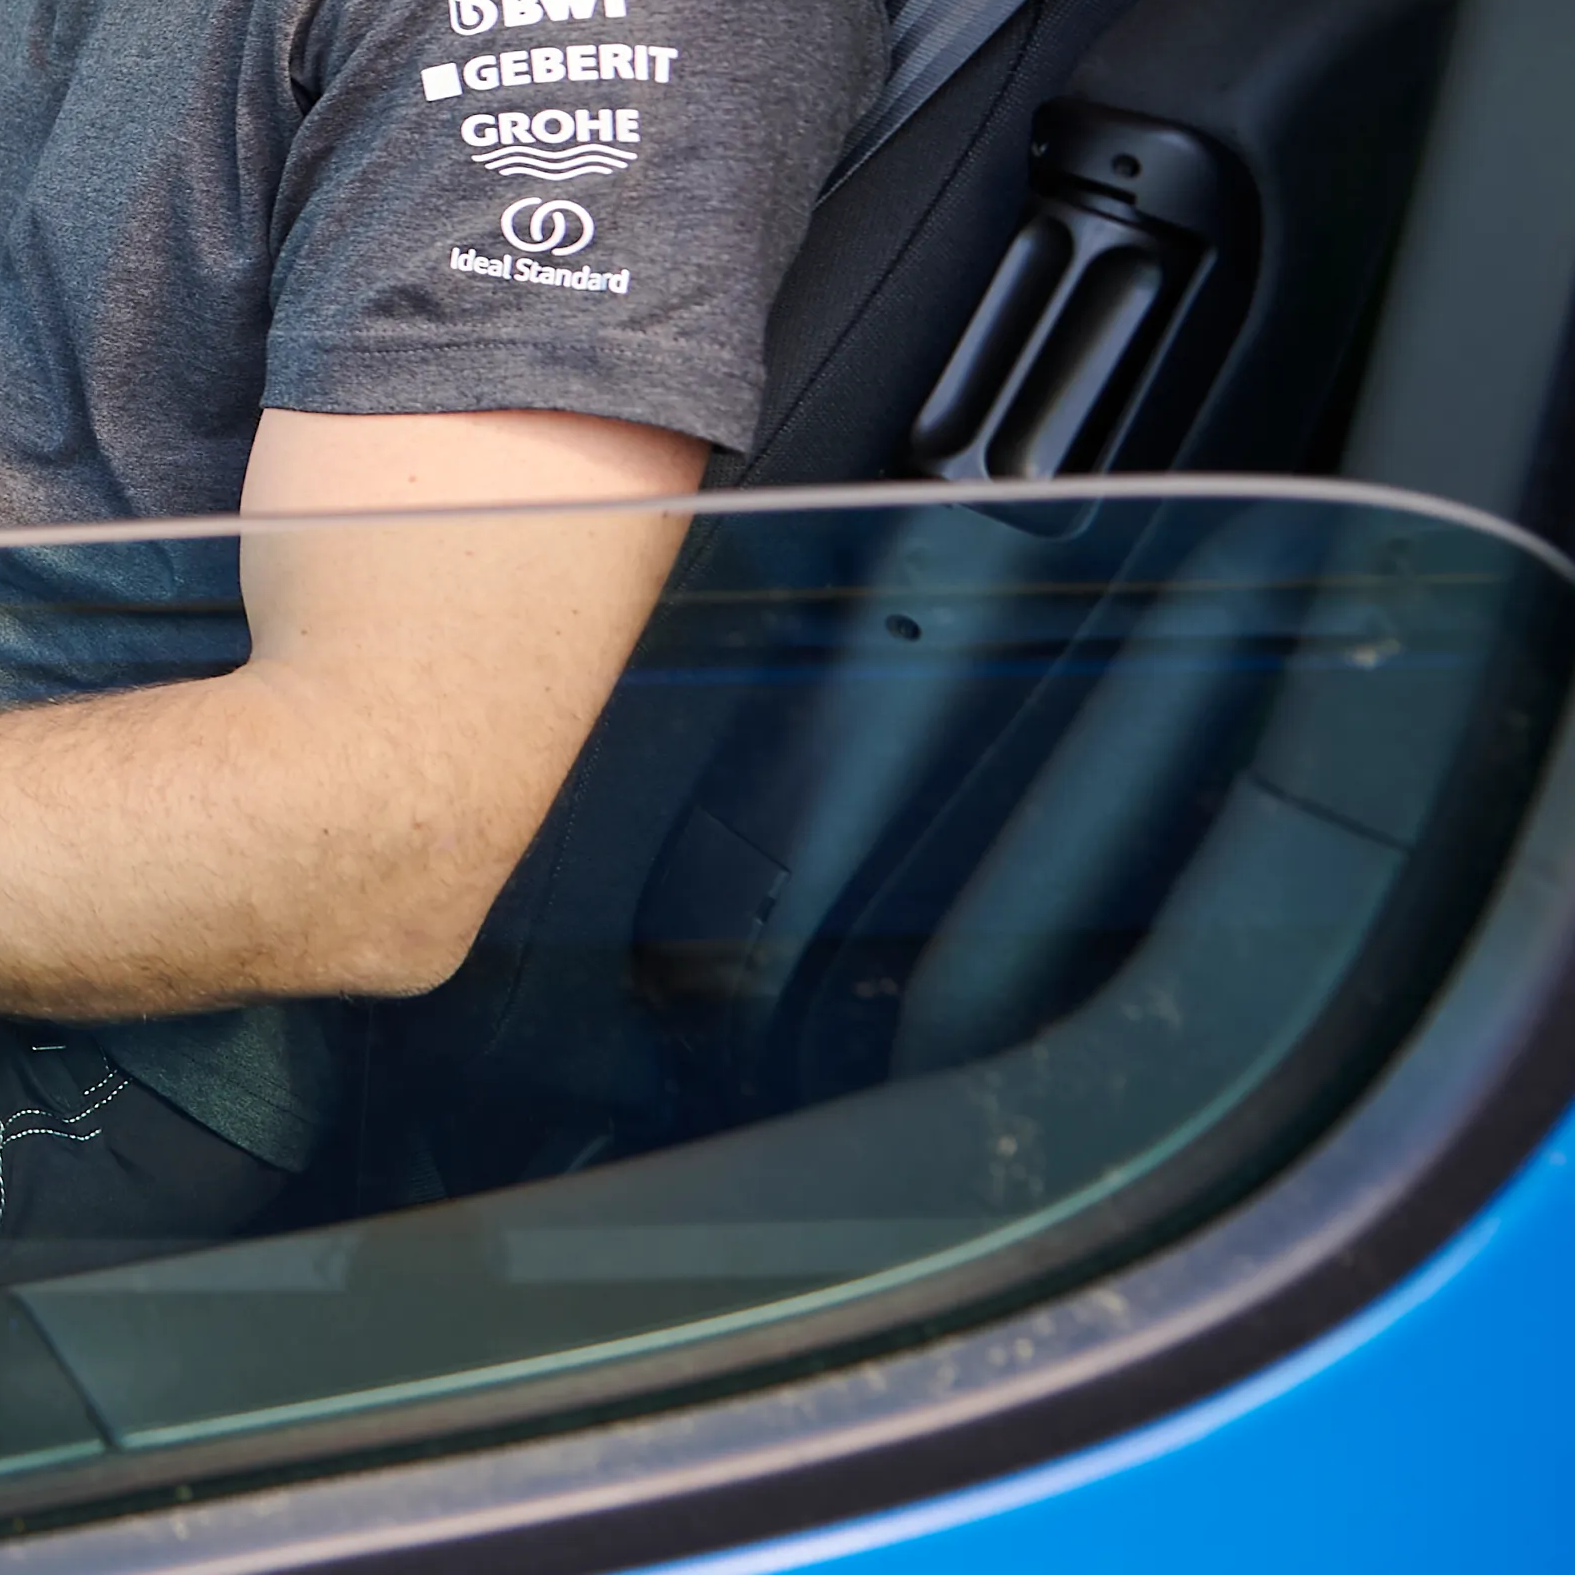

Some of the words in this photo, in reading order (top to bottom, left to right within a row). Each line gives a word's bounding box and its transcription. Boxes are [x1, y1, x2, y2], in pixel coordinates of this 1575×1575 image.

[462, 43, 679, 91] GEBERIT
[460, 108, 641, 147] GROHE
[449, 247, 513, 281] Ideal
[513, 257, 631, 295] Standard
